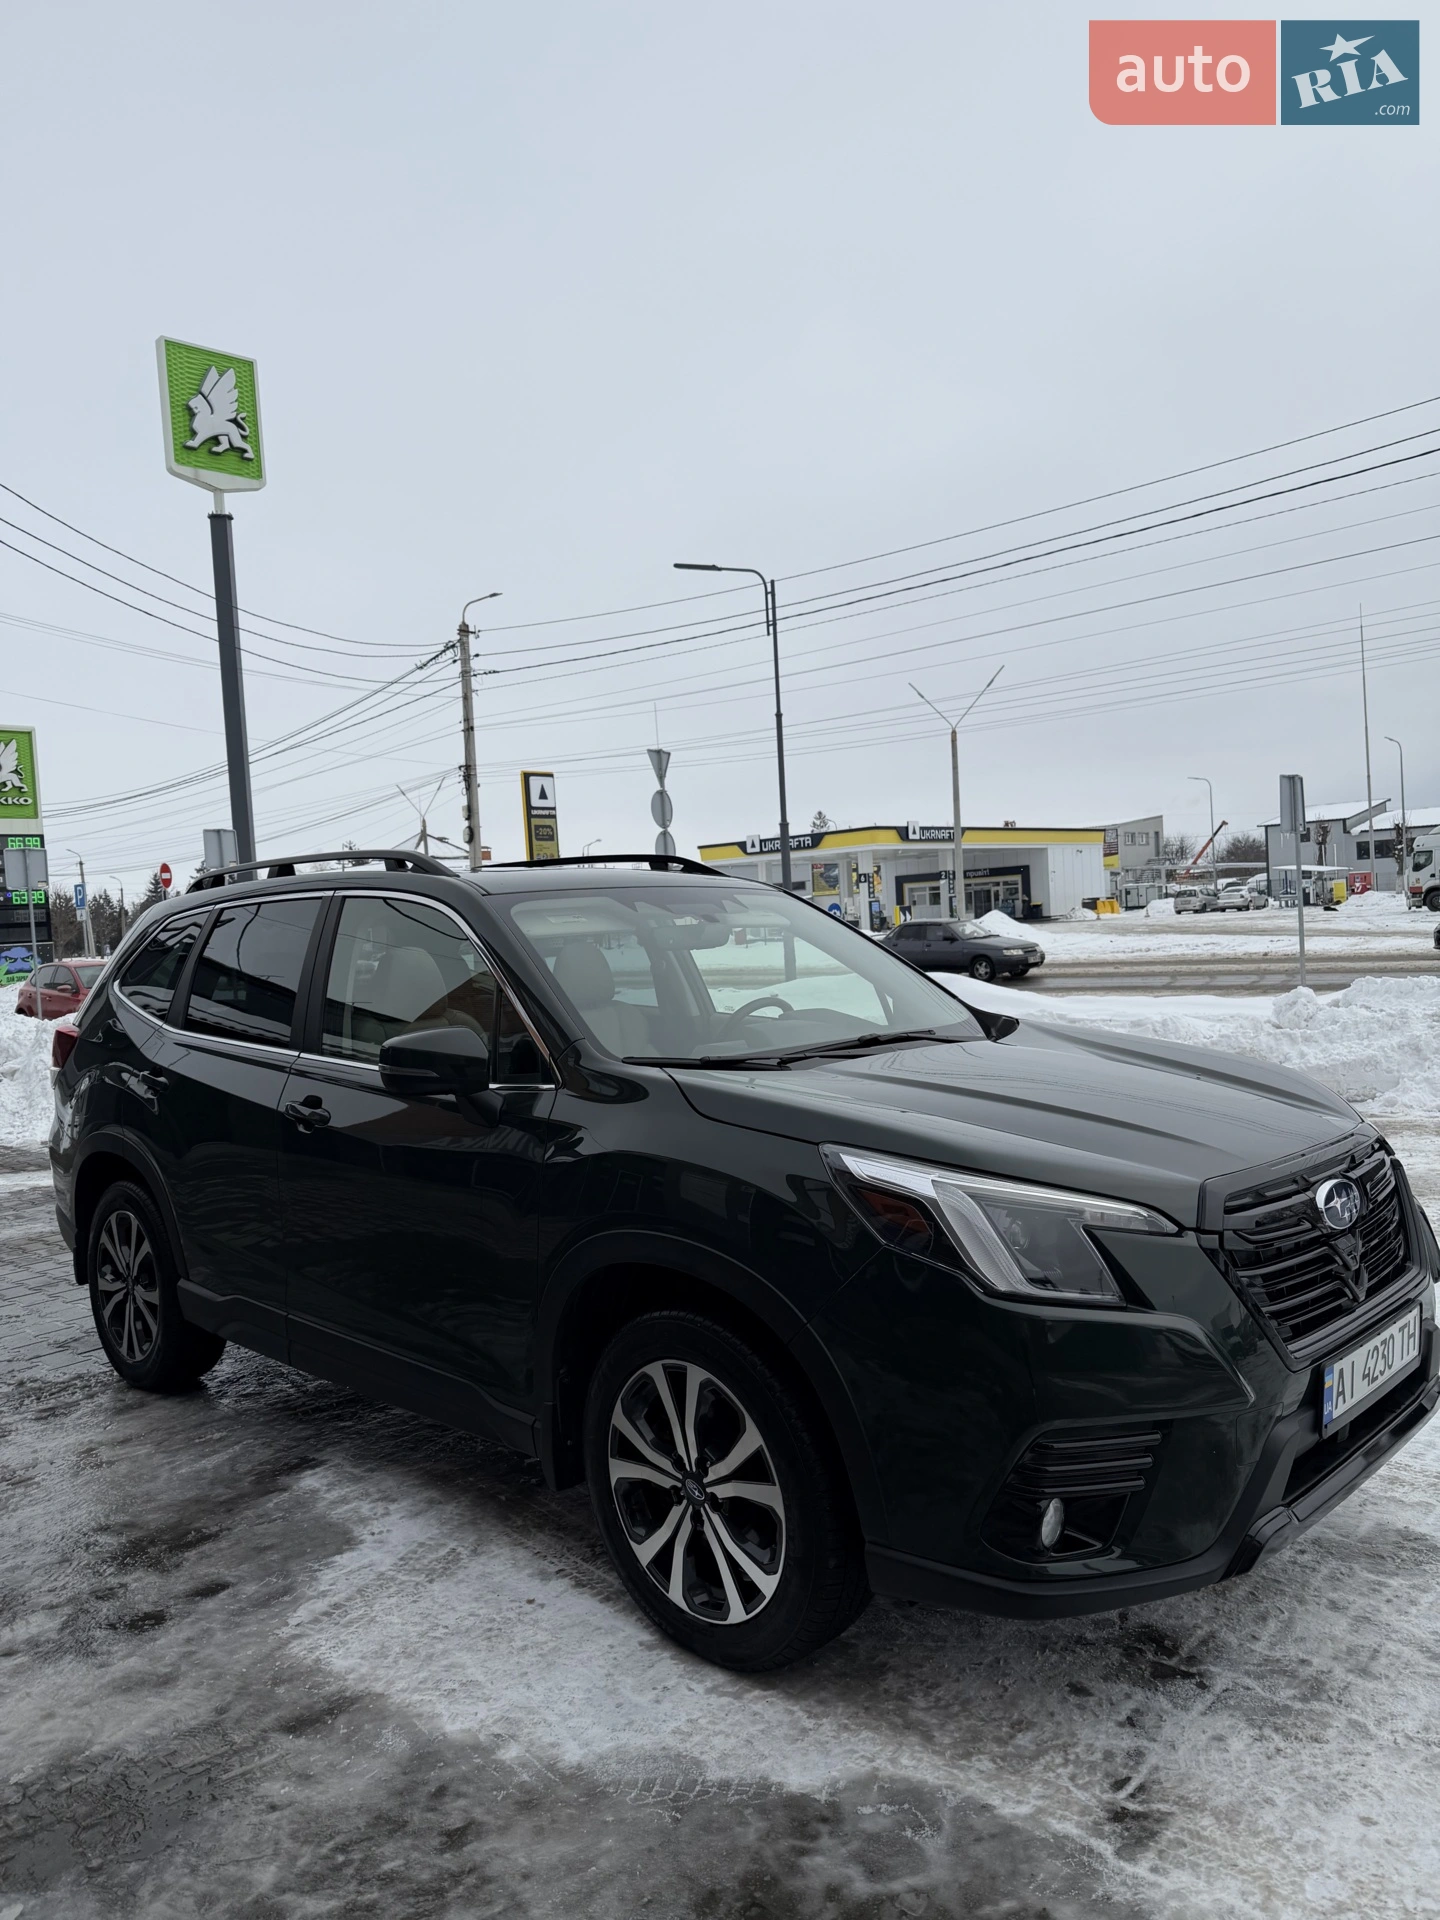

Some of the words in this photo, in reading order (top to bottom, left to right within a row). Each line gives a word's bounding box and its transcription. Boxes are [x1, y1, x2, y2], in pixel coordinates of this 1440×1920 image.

[920, 829, 955, 840] UKRNAFT
[761, 836, 812, 852] UKRAFTA
[941, 871, 946, 879] 2
[77, 887, 83, 906] P
[1335, 1360, 1355, 1410] AI
[1362, 1333, 1395, 1387] 4230
[1399, 1315, 1417, 1361] TH
[1324, 1400, 1332, 1415] UA
